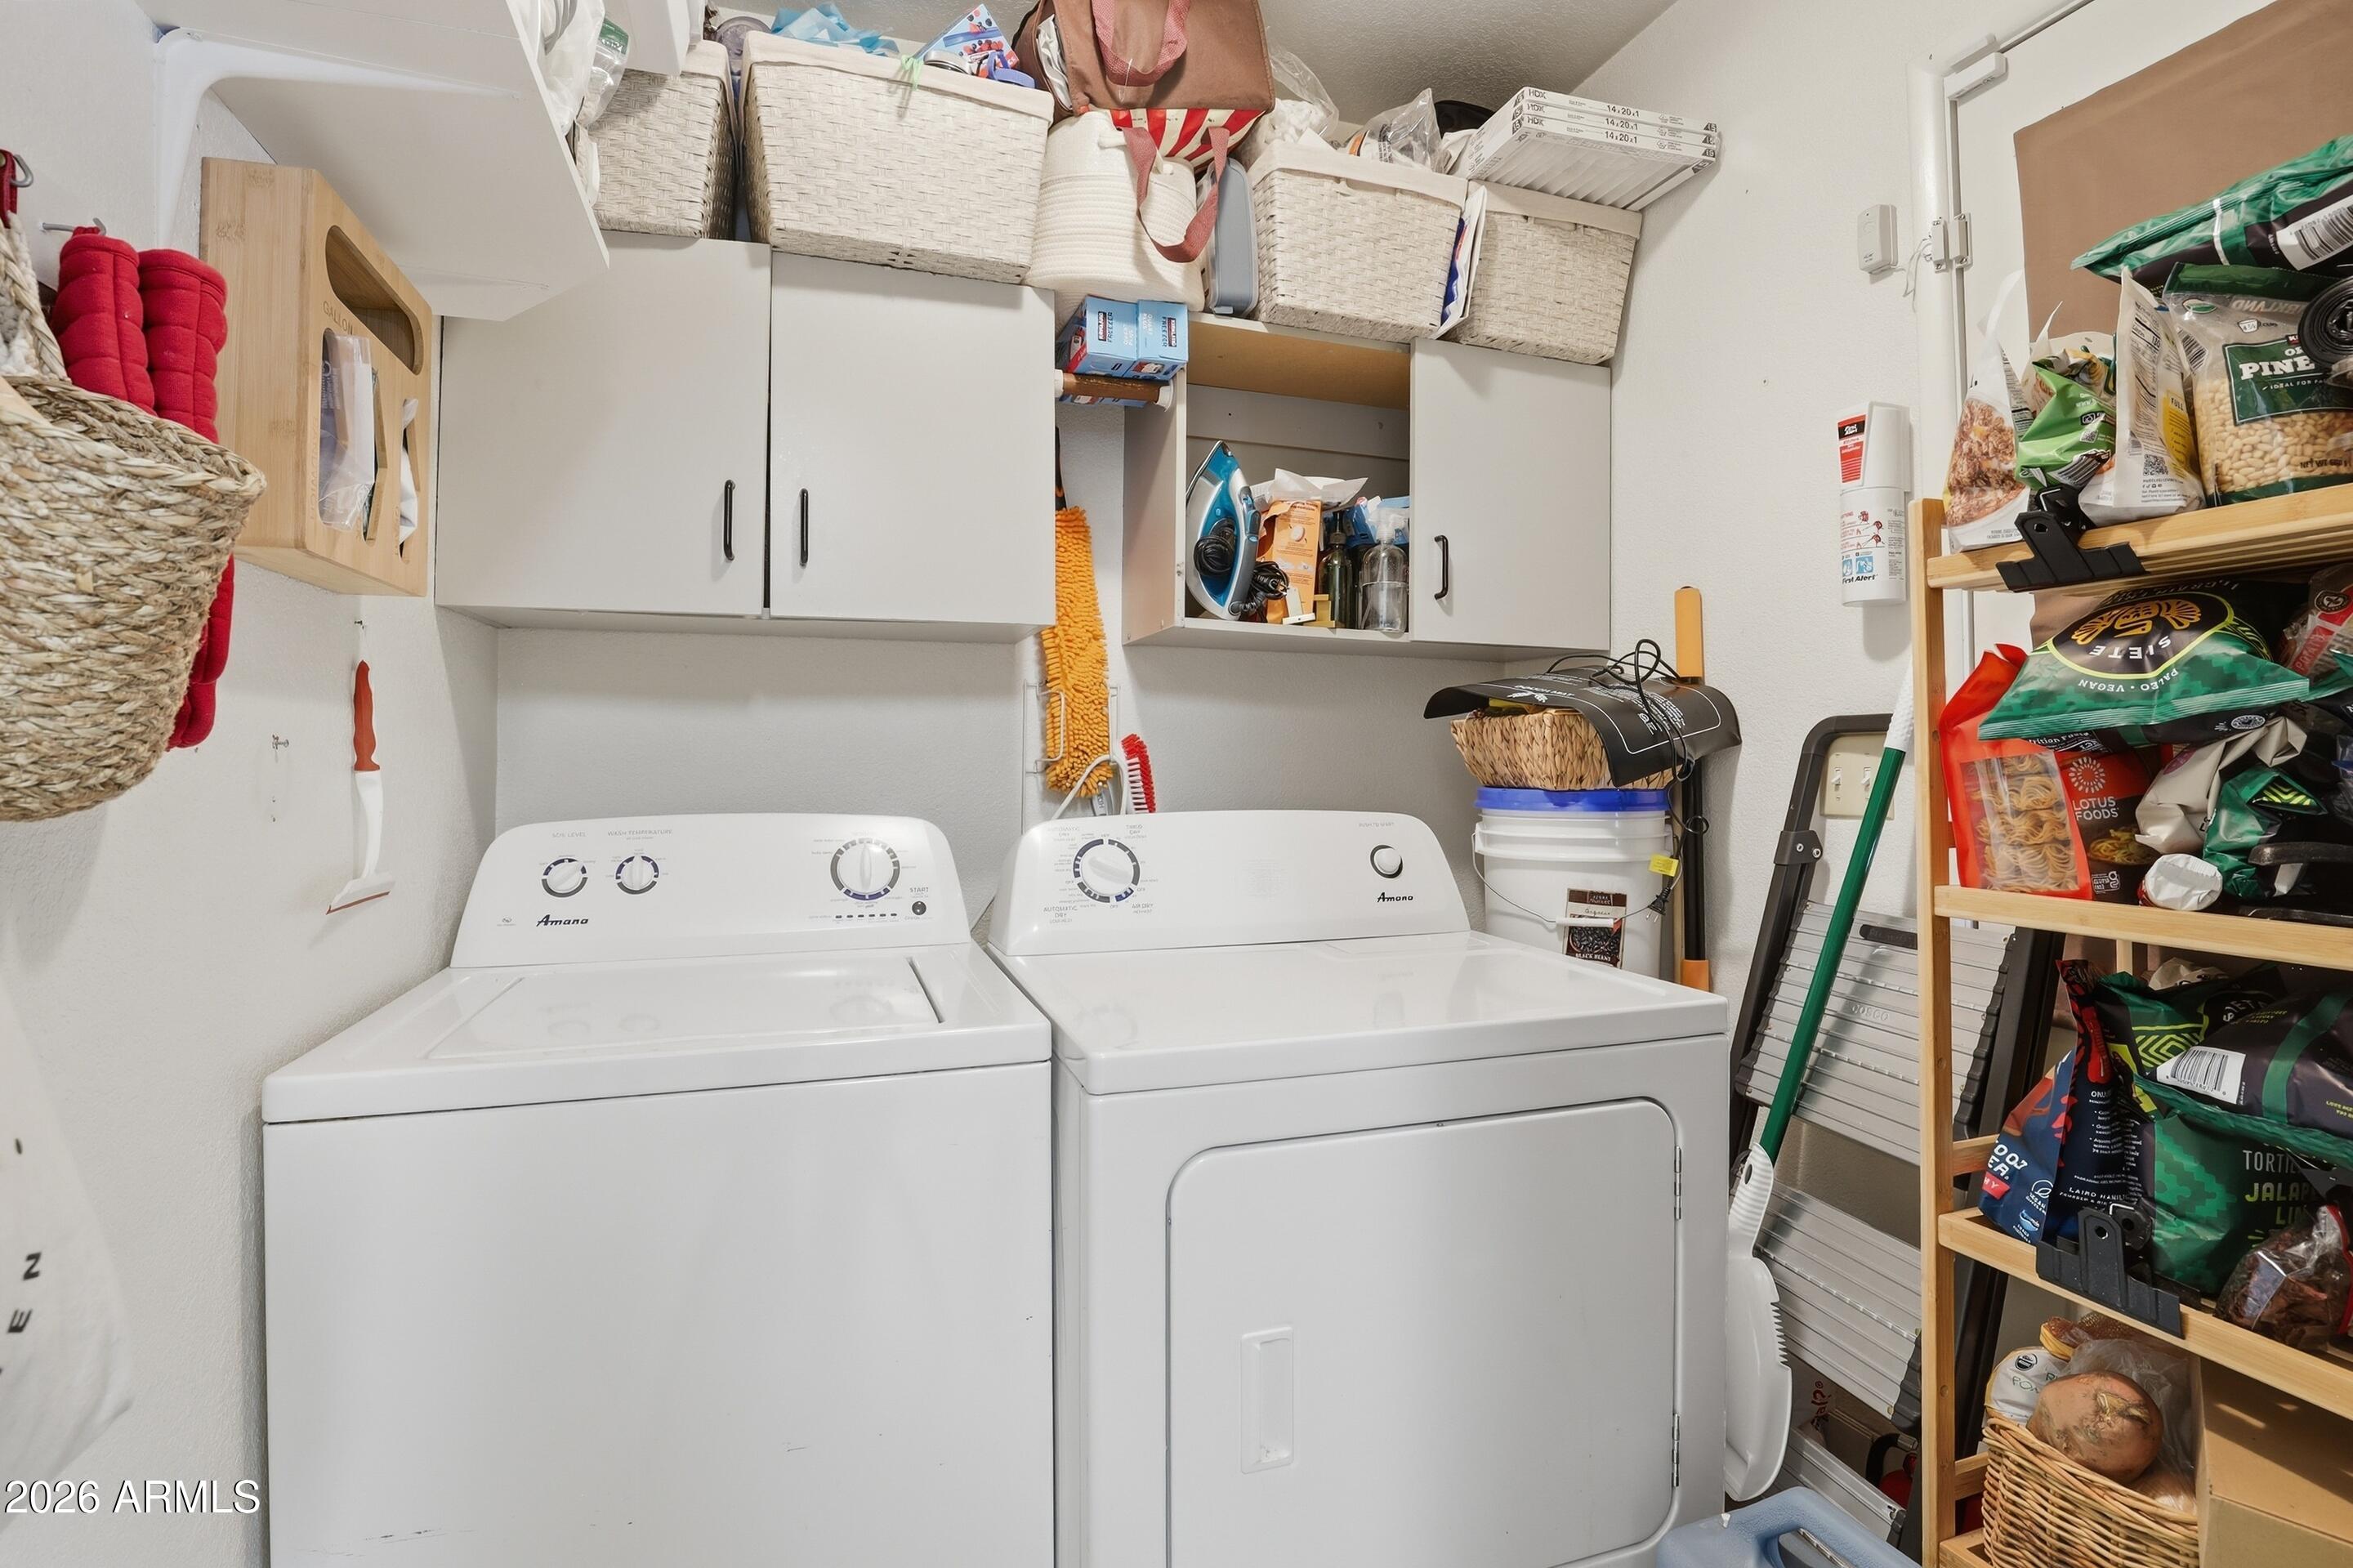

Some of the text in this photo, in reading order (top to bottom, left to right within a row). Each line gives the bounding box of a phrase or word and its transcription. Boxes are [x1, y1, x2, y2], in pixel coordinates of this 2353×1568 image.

[1529, 88, 1547, 100] HDX
[1526, 102, 1545, 114] HDX
[1526, 116, 1544, 127] HDX
[323, 301, 354, 336] GALLON
[2239, 355, 2315, 381] PINE
[2270, 382, 2295, 391] IDEAL
[2170, 397, 2184, 411] FULL
[1855, 574, 1876, 583] Alert
[2089, 635, 2172, 659] SIETE
[2078, 668, 2180, 693] PALEO VEGAN
[2072, 796, 2116, 811] LOTUS
[2075, 807, 2119, 821] FOODS
[1377, 891, 1414, 903] Amana
[535, 914, 589, 927] Amana
[2068, 1187, 2096, 1198] LAIRD
